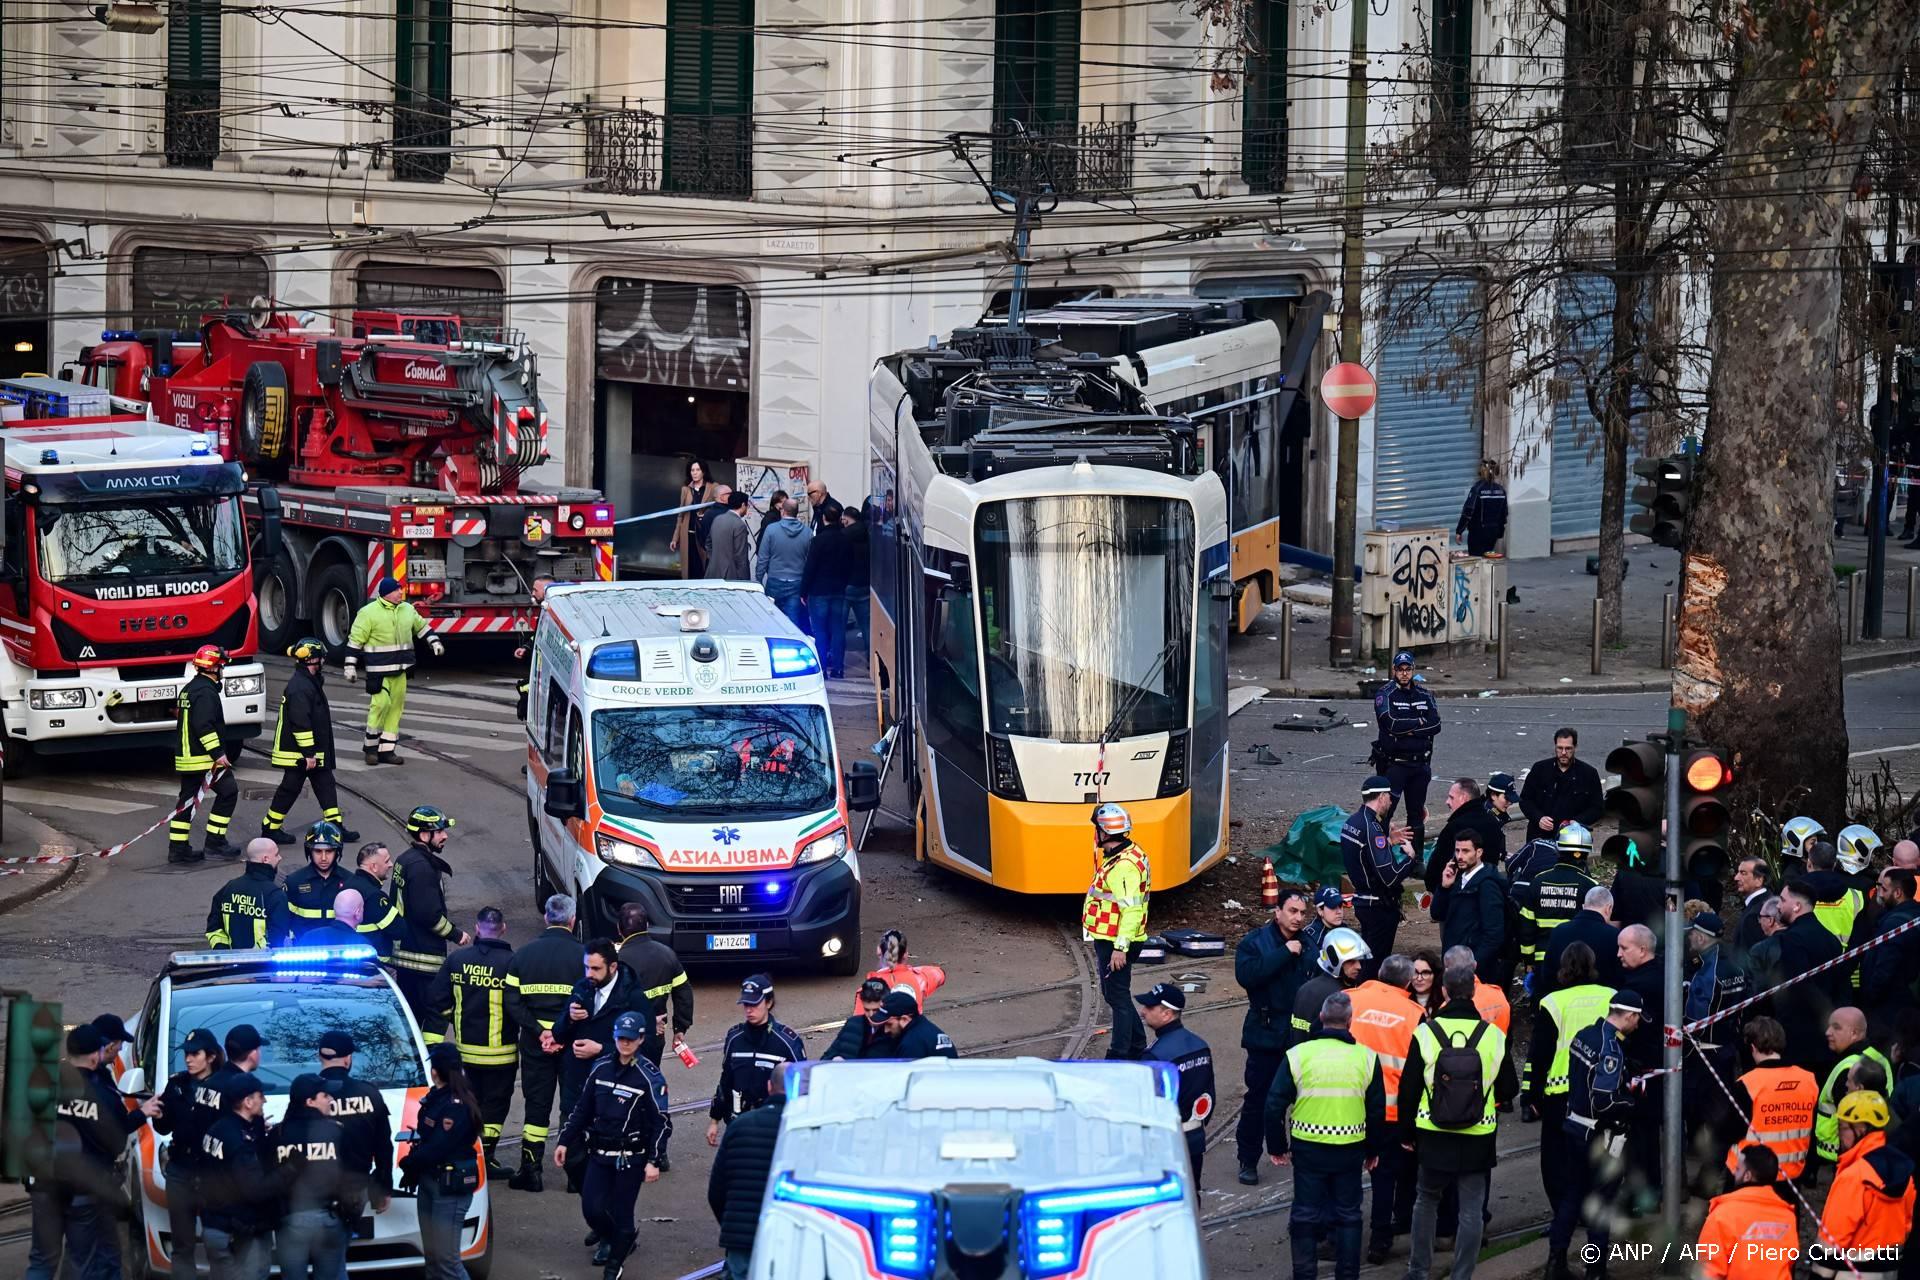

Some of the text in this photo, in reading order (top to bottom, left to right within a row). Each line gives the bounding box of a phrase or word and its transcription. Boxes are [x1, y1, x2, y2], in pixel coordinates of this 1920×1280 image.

[766, 239, 815, 250] LAZZARETTO
[173, 393, 196, 409] VIGILI
[175, 412, 191, 428] DEL
[408, 425, 428, 437] MILANO
[106, 475, 180, 489] MAXI CITY
[95, 580, 209, 600] VIGILI DEL FUOCO
[119, 614, 188, 632] IVECO
[139, 688, 175, 699] VF 29735
[612, 685, 694, 696] CROCE VERDE
[1073, 772, 1110, 786] 7707
[231, 893, 256, 906] VIGILI
[719, 885, 744, 904] FIAT
[463, 963, 493, 978] VIGILI
[524, 985, 542, 993] VIGILI
[329, 1096, 374, 1117] OLIZIA
[1760, 1102, 1813, 1113] CONTROLLO
[1764, 1114, 1808, 1125] ESERCIZIO
